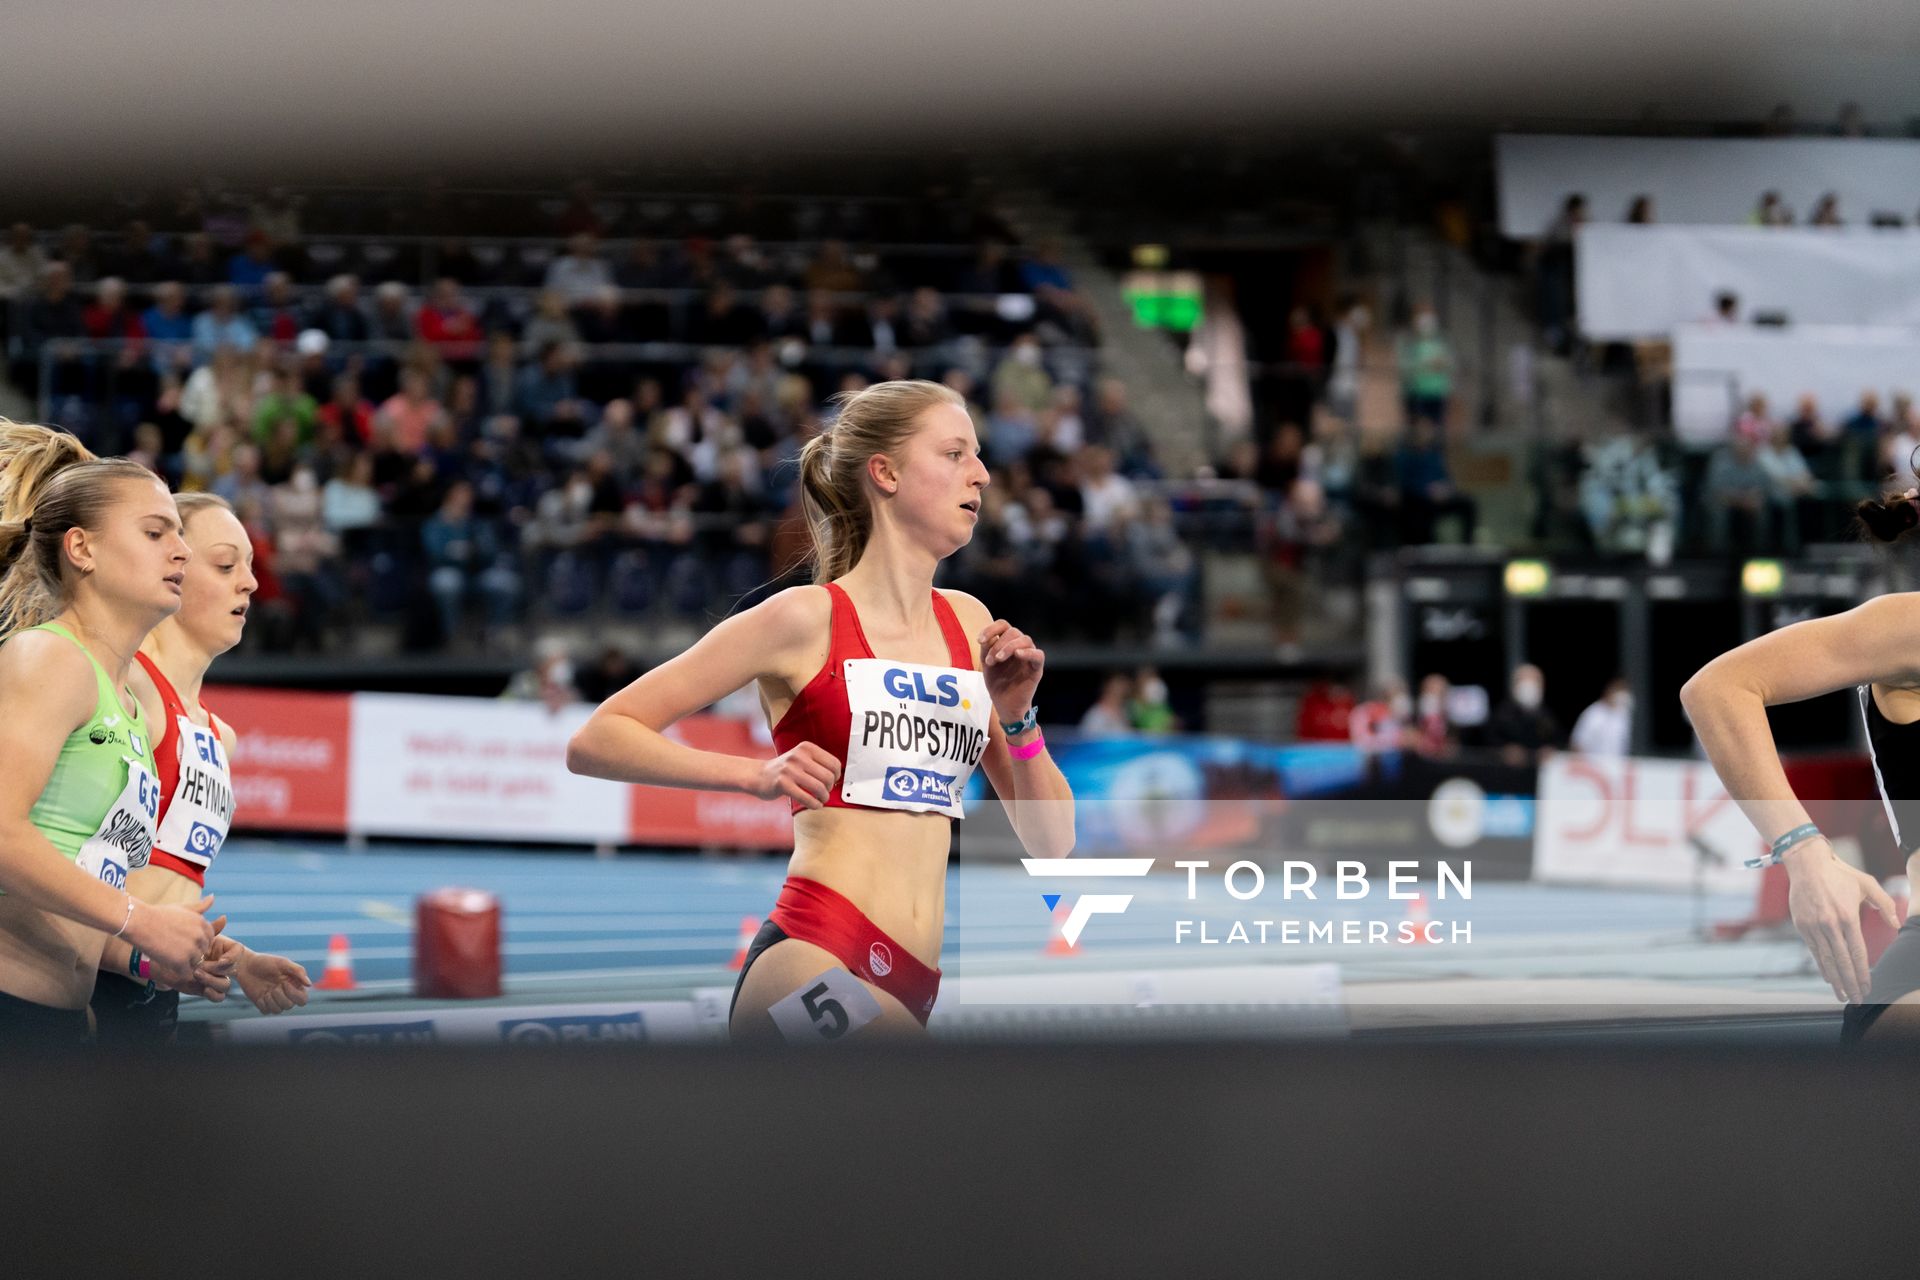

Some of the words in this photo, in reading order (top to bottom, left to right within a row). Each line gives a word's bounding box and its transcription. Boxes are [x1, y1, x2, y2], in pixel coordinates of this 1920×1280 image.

[194, 732, 223, 769] GL
[862, 702, 984, 766] PRÖPSTING
[138, 771, 158, 819] GS
[800, 981, 849, 1039] 5
